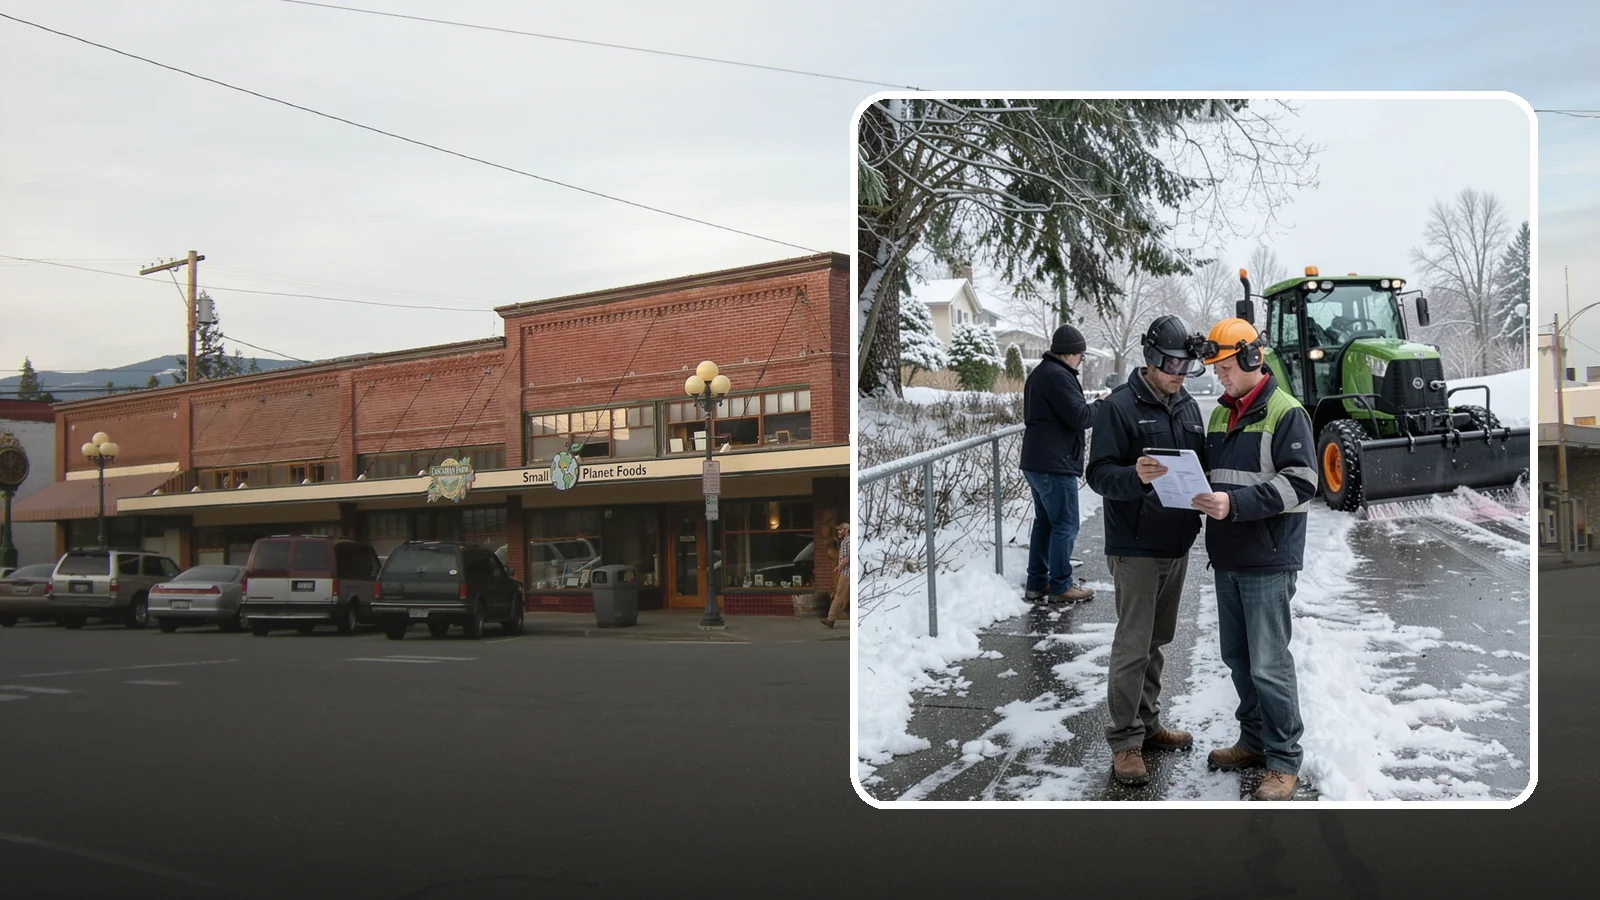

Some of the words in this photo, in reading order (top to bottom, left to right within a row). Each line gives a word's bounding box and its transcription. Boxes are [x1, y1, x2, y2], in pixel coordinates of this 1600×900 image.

[523, 471, 549, 483] Small
[583, 467, 614, 479] Planet
[617, 464, 647, 477] Foods
